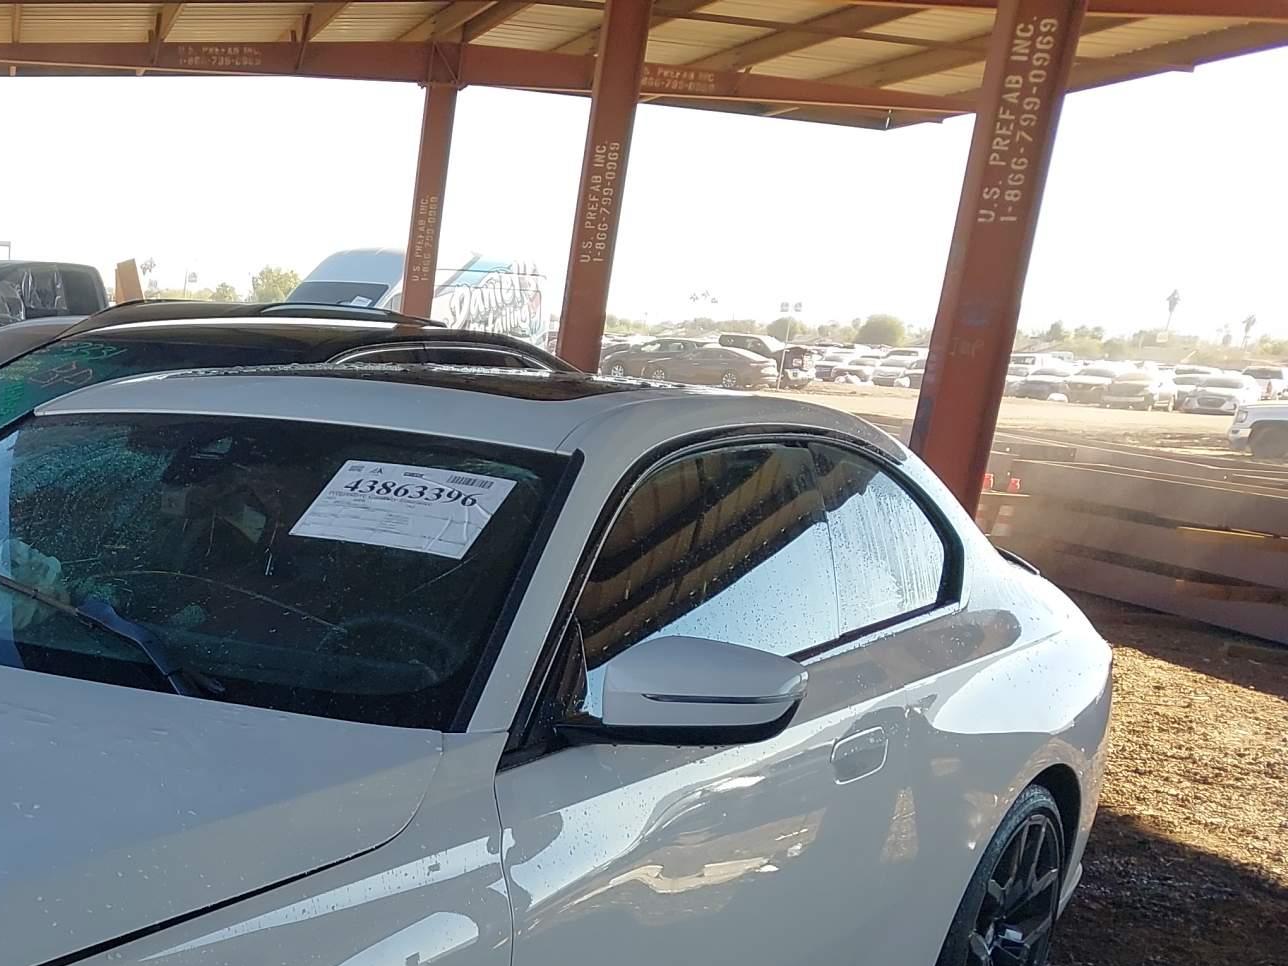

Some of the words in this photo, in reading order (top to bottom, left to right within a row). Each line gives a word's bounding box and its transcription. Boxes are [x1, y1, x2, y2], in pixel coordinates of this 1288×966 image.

[1010, 15, 1037, 62] INC.
[988, 74, 1023, 166] PREFAB
[1000, 17, 1058, 222] 1-866-799-0969
[584, 175, 602, 229] PREFAB
[593, 142, 620, 263] 1-866-799-0969
[977, 179, 1003, 224] U.S.
[343, 477, 485, 507] 43863396
